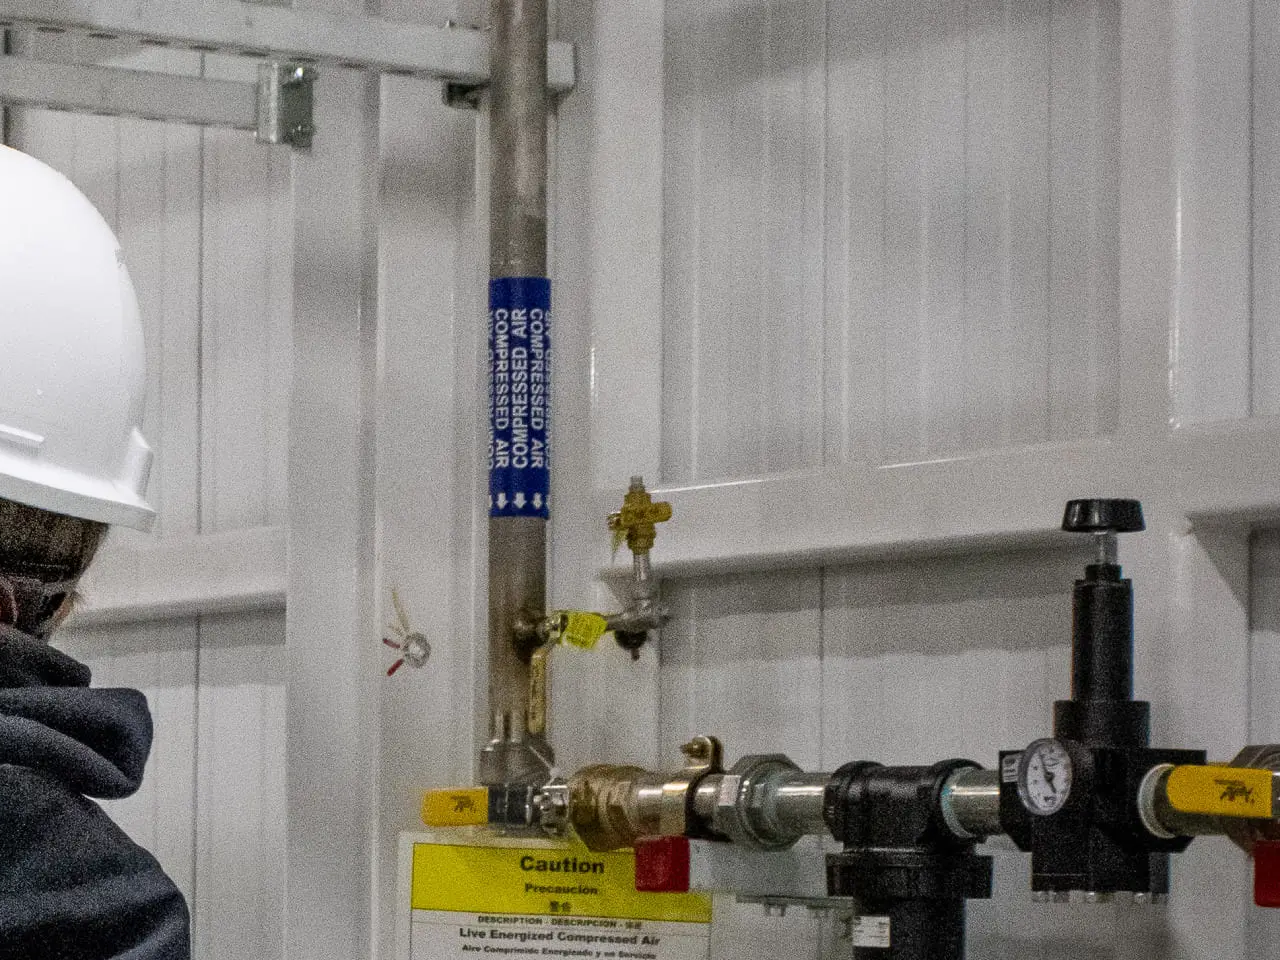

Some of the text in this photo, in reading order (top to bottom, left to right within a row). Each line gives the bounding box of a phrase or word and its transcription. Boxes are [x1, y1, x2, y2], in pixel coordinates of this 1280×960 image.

[495, 308, 509, 468] COMPRESSED AIR
[511, 308, 528, 468] COMPRESSED AIR
[530, 308, 544, 468] COMPRESSED AIR
[520, 856, 605, 874] Caution
[525, 883, 598, 895] Precaucion
[478, 915, 542, 924] DESCRIPTION
[551, 918, 617, 928] DESCRIPCION
[459, 928, 661, 945] Live Energized Compressed Air
[462, 944, 482, 952] Aire
